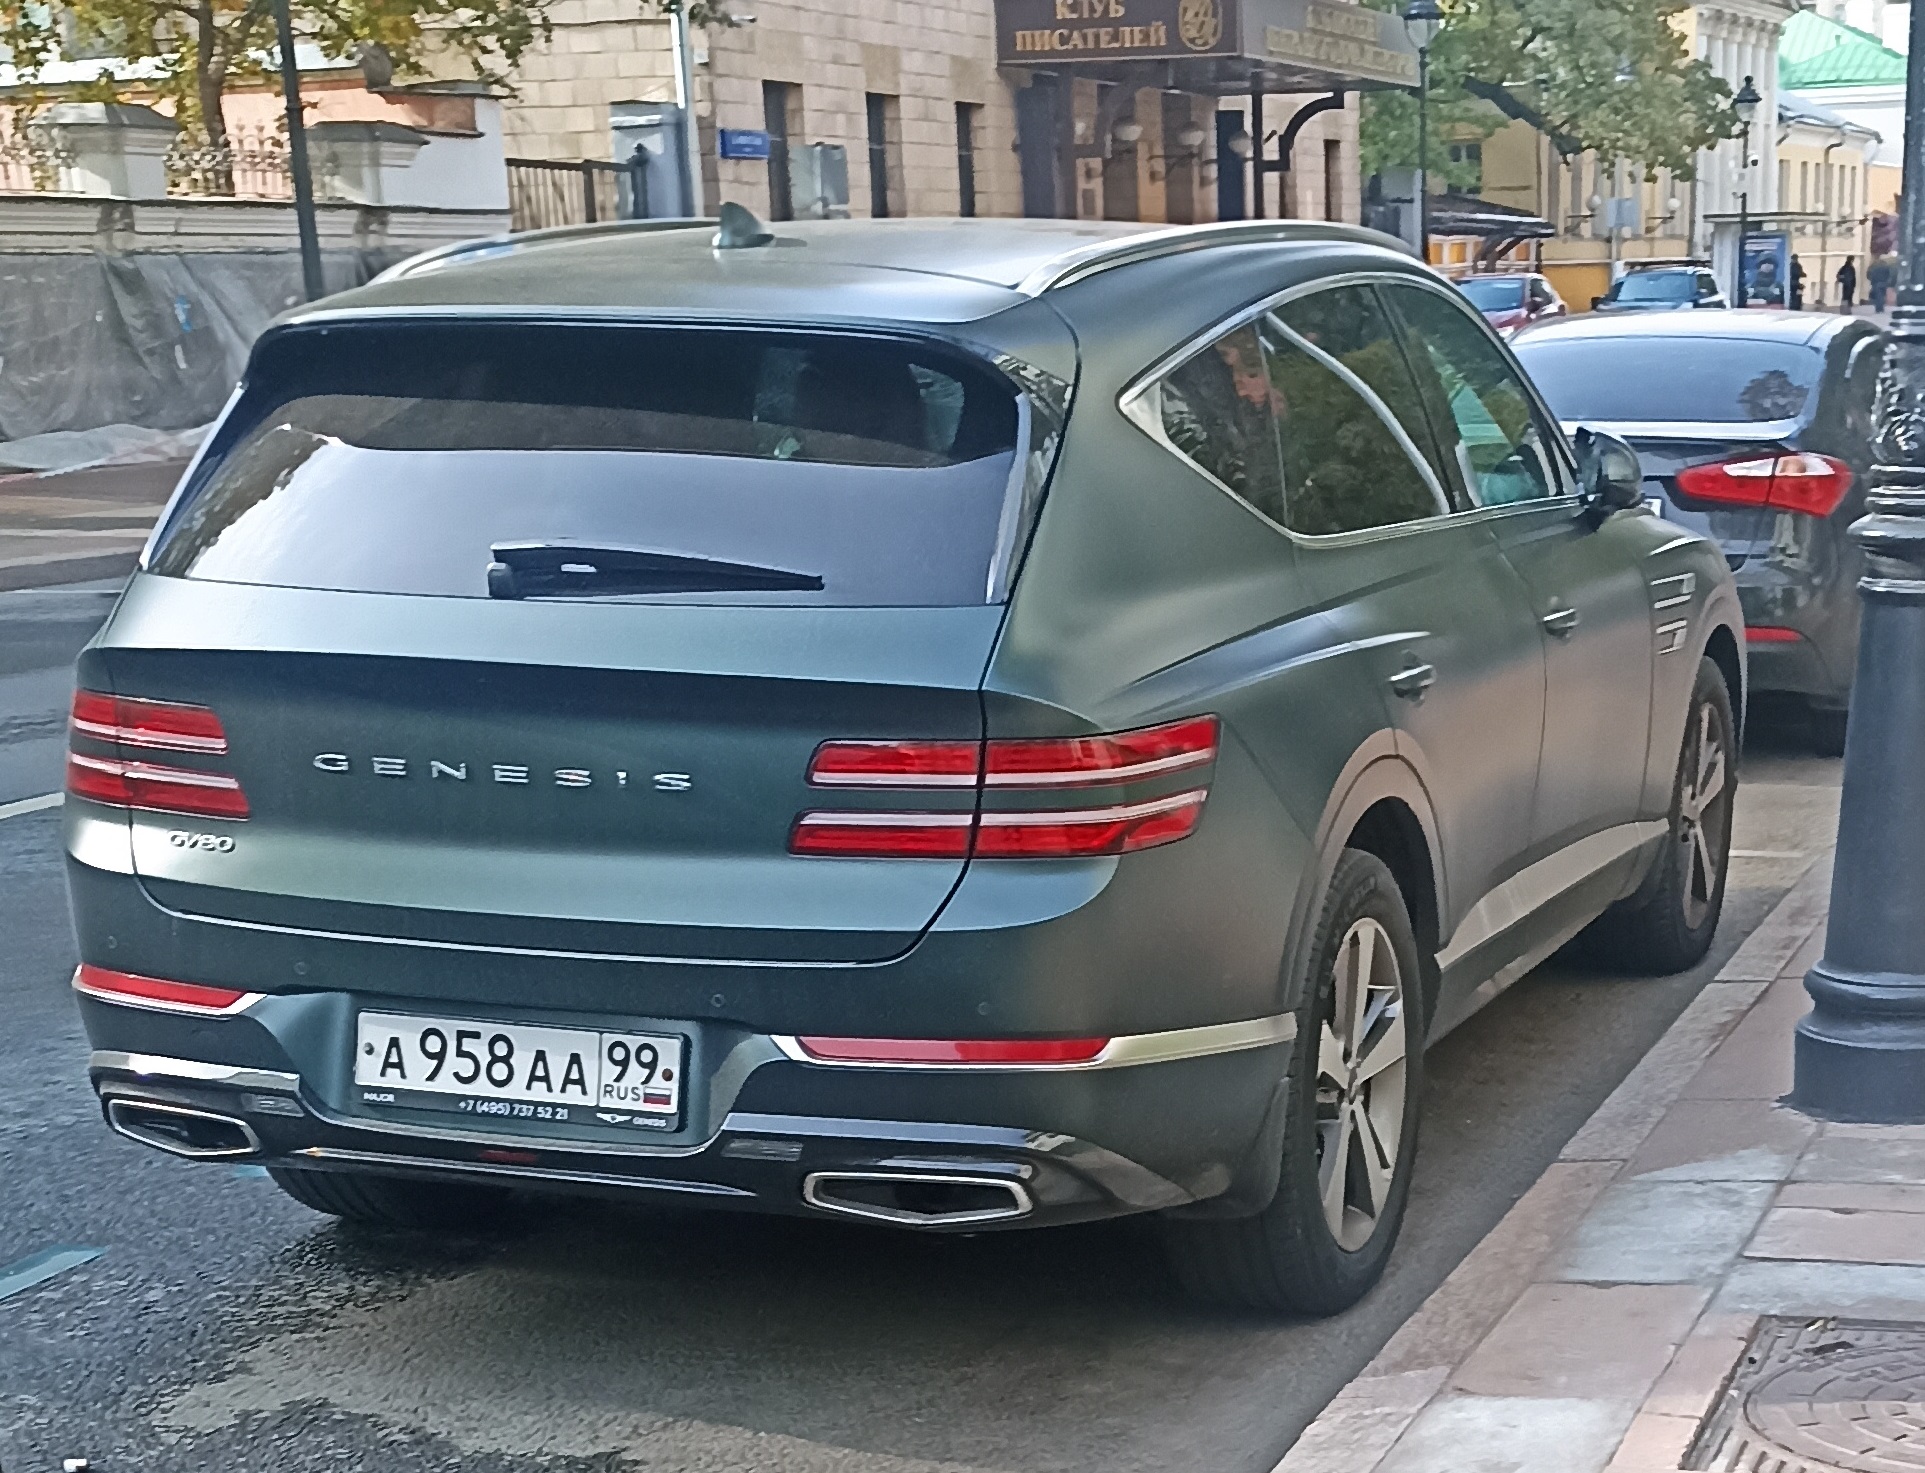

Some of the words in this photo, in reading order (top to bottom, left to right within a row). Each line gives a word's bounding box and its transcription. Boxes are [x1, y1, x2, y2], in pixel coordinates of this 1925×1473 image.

[1016, 20, 1166, 51] ПИСАТЕЛЕЙ
[312, 752, 692, 791] GENESIS
[168, 828, 235, 853] GV80
[603, 1083, 641, 1102] RUS
